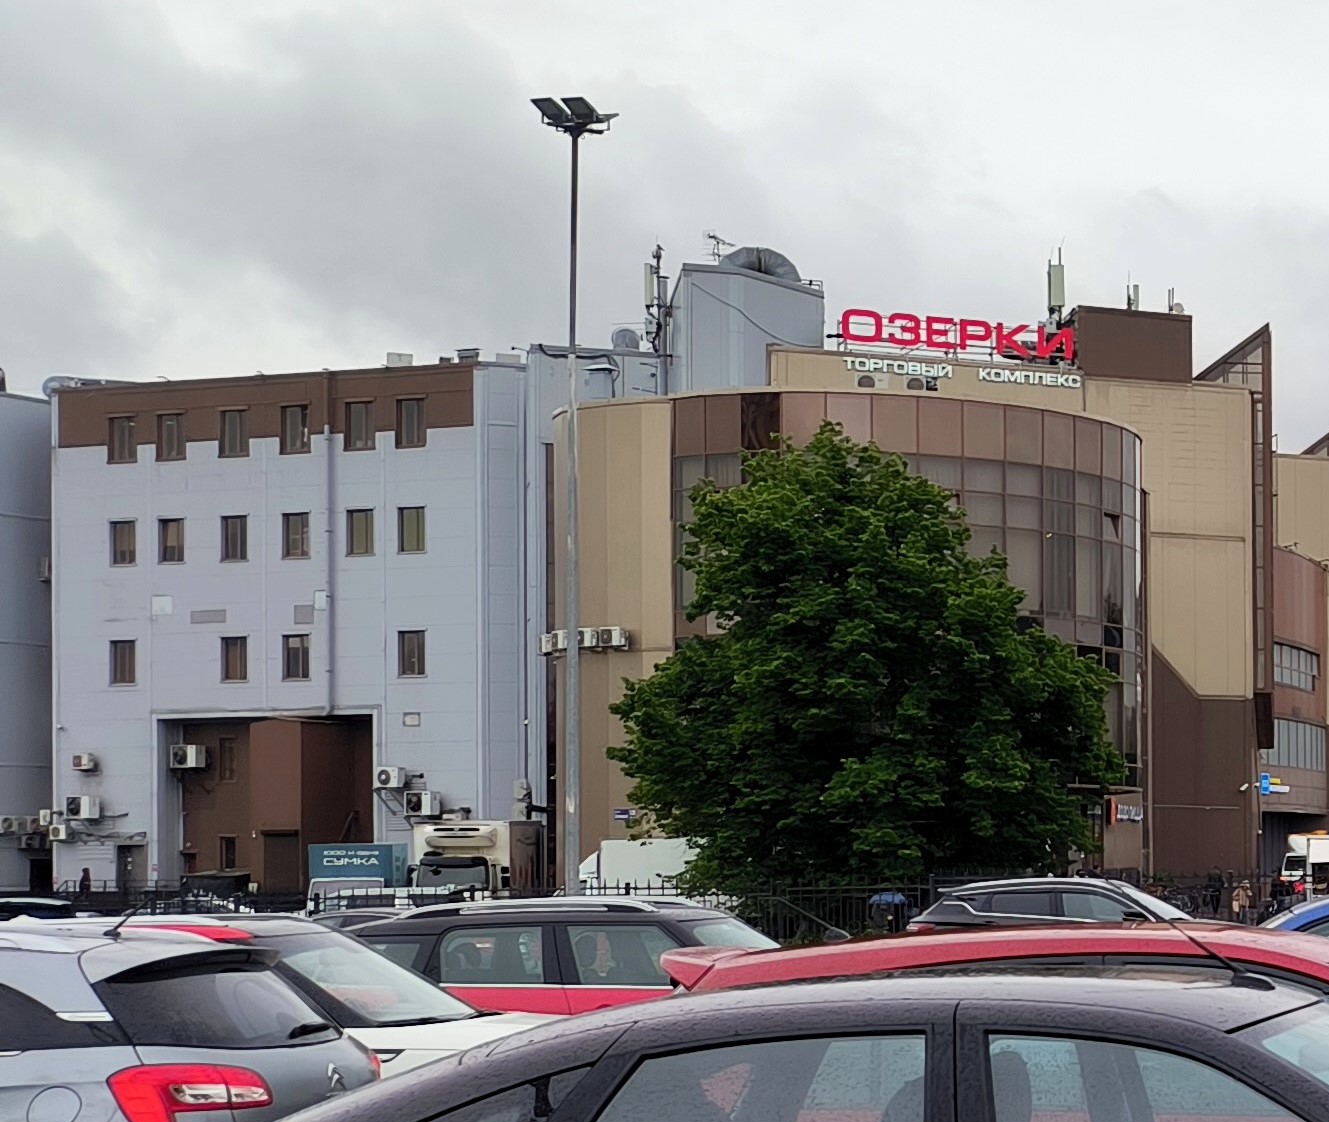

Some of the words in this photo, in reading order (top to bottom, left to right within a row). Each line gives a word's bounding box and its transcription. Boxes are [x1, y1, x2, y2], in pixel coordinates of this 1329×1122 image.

[841, 308, 1075, 361] ОЗЕРКИ
[842, 356, 953, 378] ТОРГОВЫЙ
[978, 367, 1082, 388] КОМПЛЕКС
[323, 857, 379, 866] СУМКА
